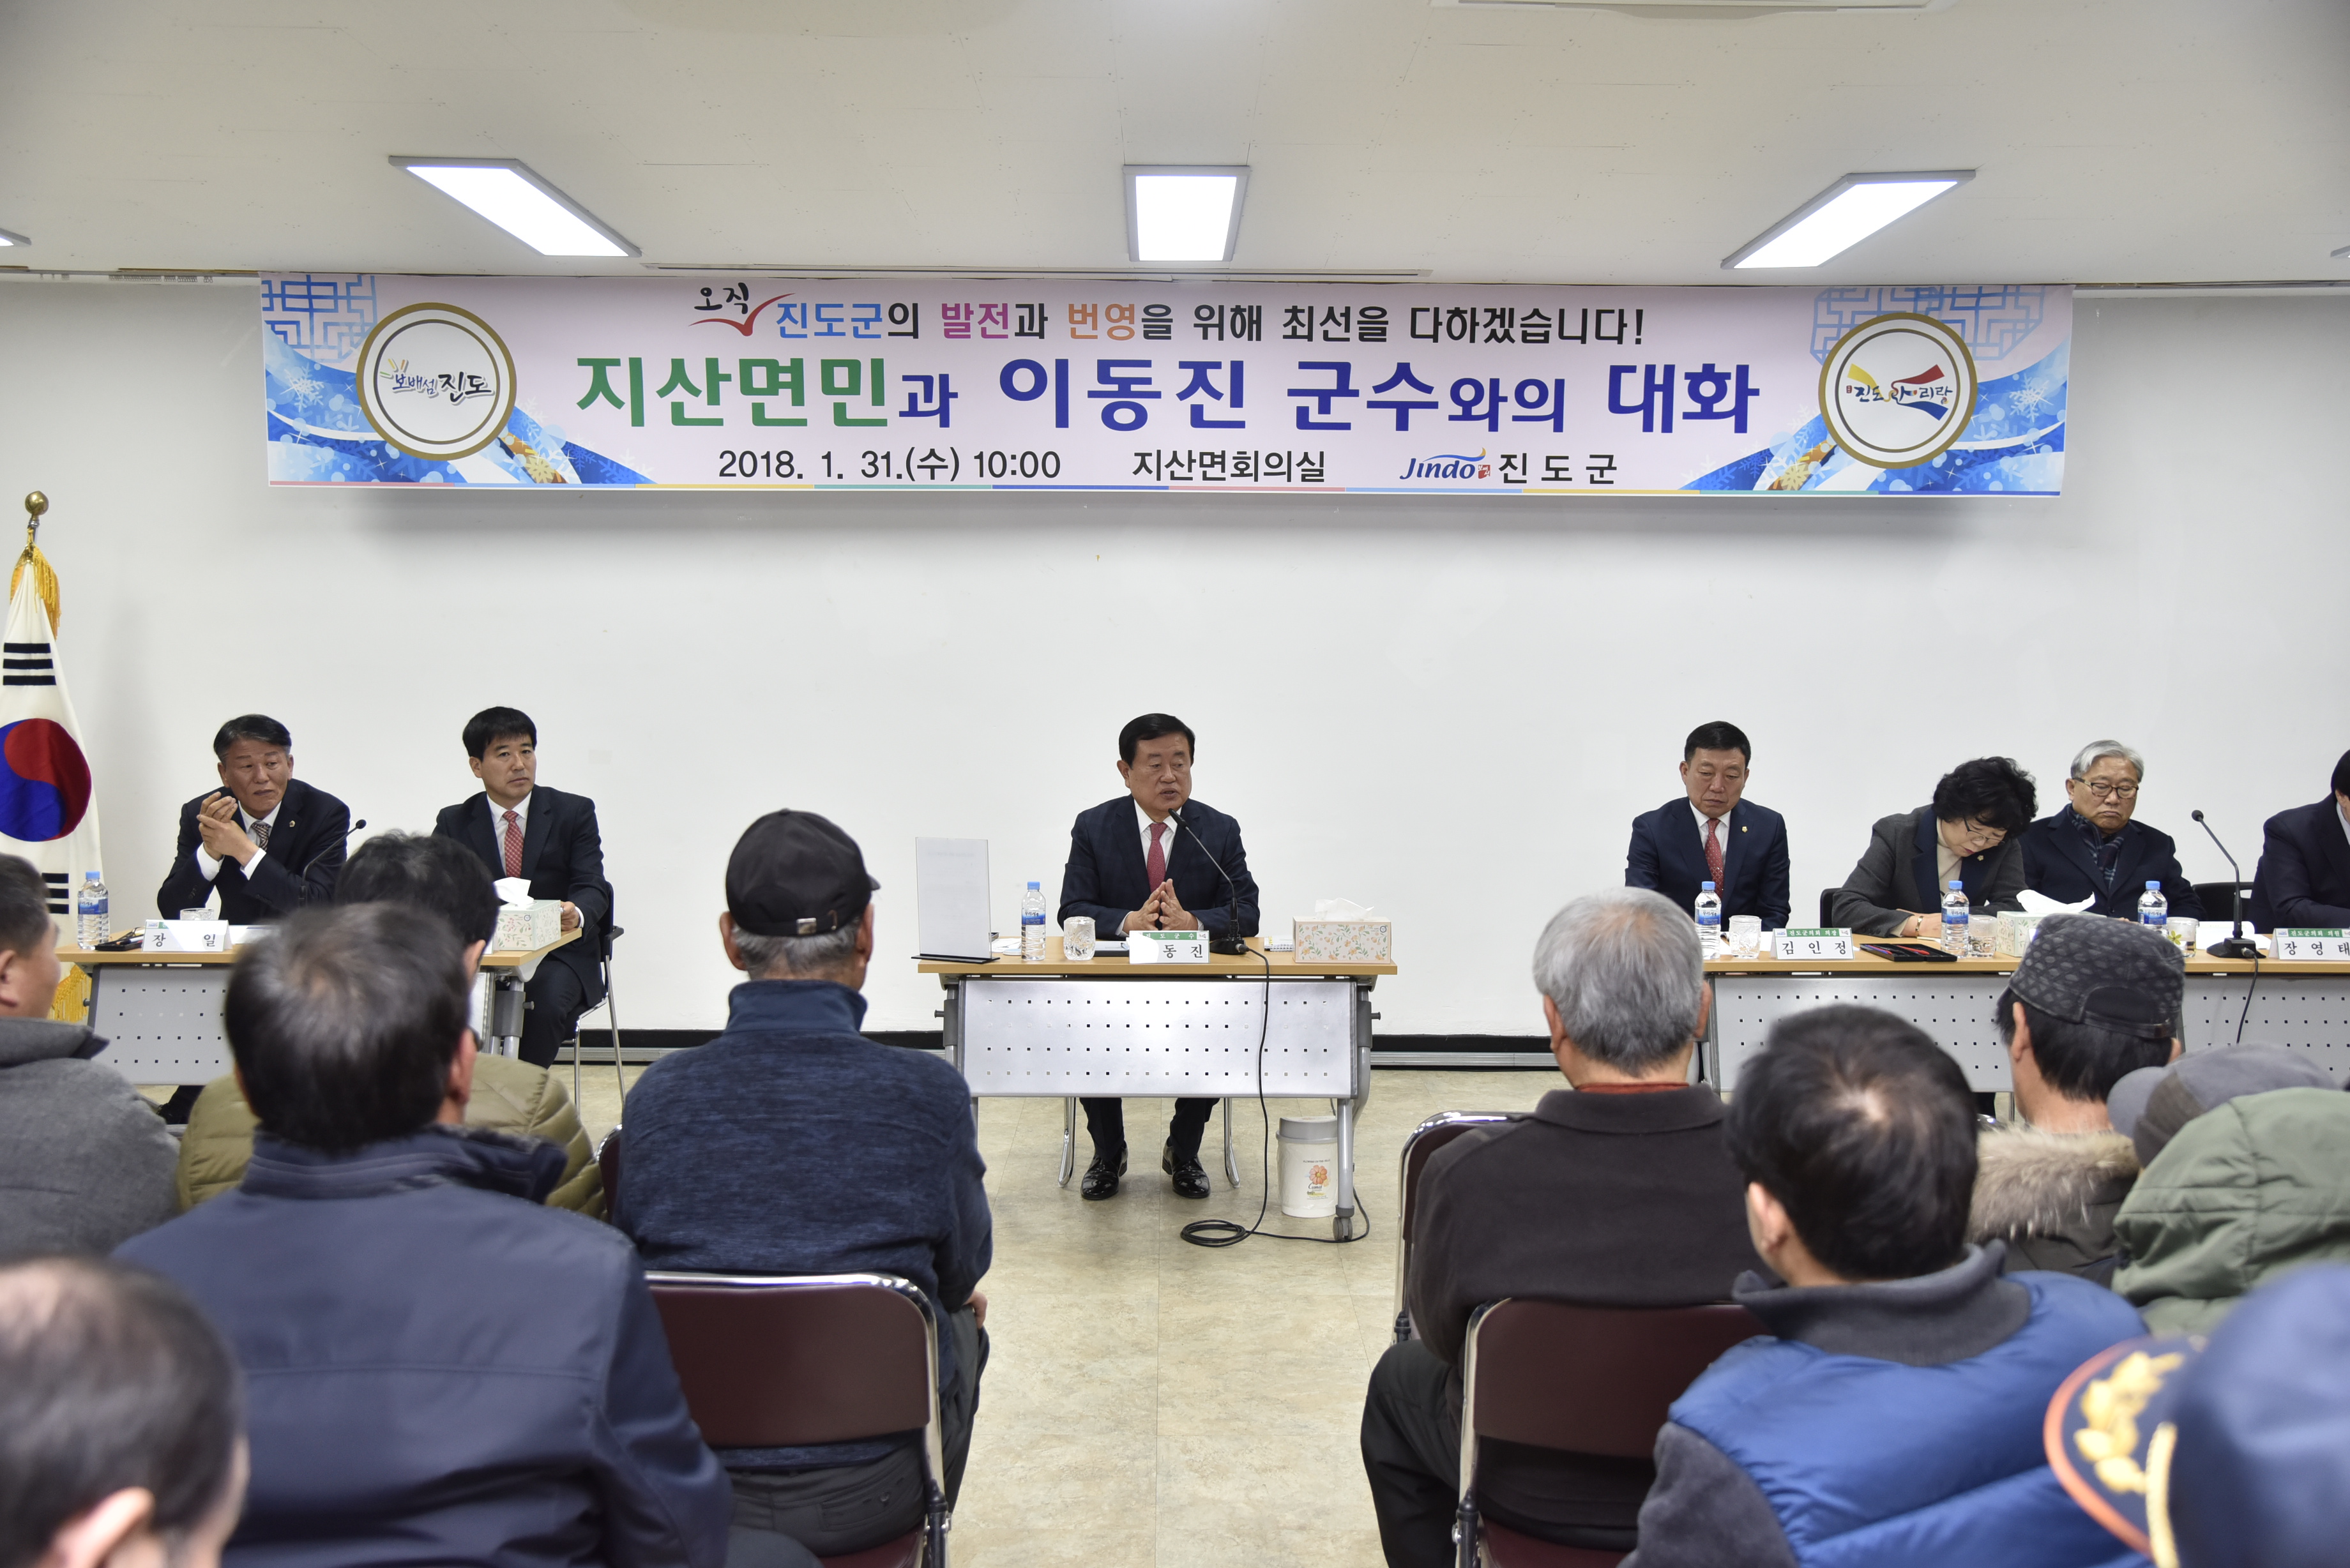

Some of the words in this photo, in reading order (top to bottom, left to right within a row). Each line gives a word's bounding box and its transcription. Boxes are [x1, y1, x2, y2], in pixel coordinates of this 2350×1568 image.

[694, 282, 750, 314] 오직
[776, 302, 920, 340] 진도군의
[941, 303, 1049, 340] 발전과
[1068, 303, 1174, 341] 번영을
[1193, 304, 1262, 342] 위해
[1282, 305, 1389, 343] 최선을
[1410, 306, 1644, 345] 다하겠습니다!
[438, 372, 492, 402] 진도
[576, 357, 959, 428] 지산면민과
[999, 358, 1246, 432] 이동진
[1287, 361, 1565, 433] 군수와의
[1607, 363, 1760, 434] 대화
[718, 449, 803, 479] 2018.
[821, 451, 844, 479] 1.
[973, 450, 1061, 480] 10:00
[1132, 449, 1325, 483] 지산면회의실
[1399, 458, 1476, 480] Jindo
